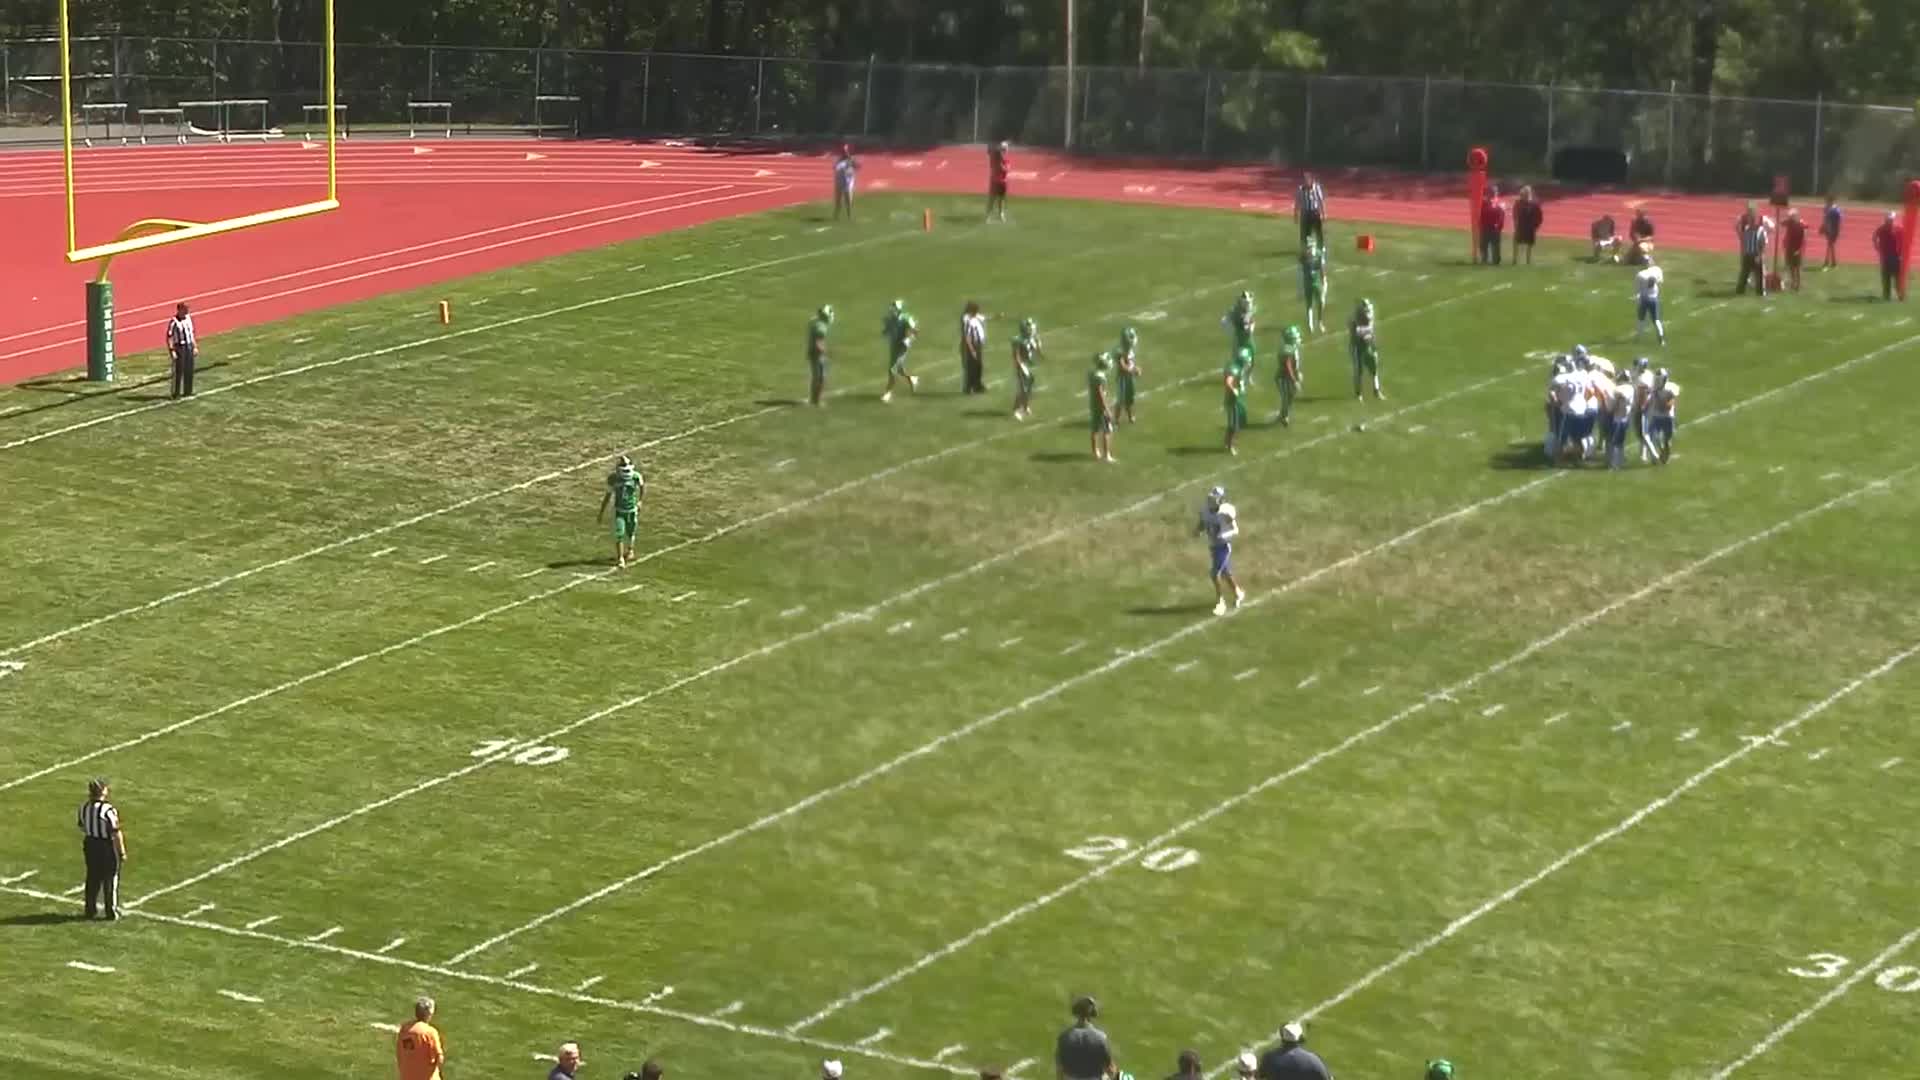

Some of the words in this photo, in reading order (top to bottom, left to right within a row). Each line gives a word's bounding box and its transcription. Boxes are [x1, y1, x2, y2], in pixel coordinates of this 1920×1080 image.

[470, 739, 569, 765] 10
[1063, 836, 1200, 872] 20
[1787, 953, 1920, 992] 30
